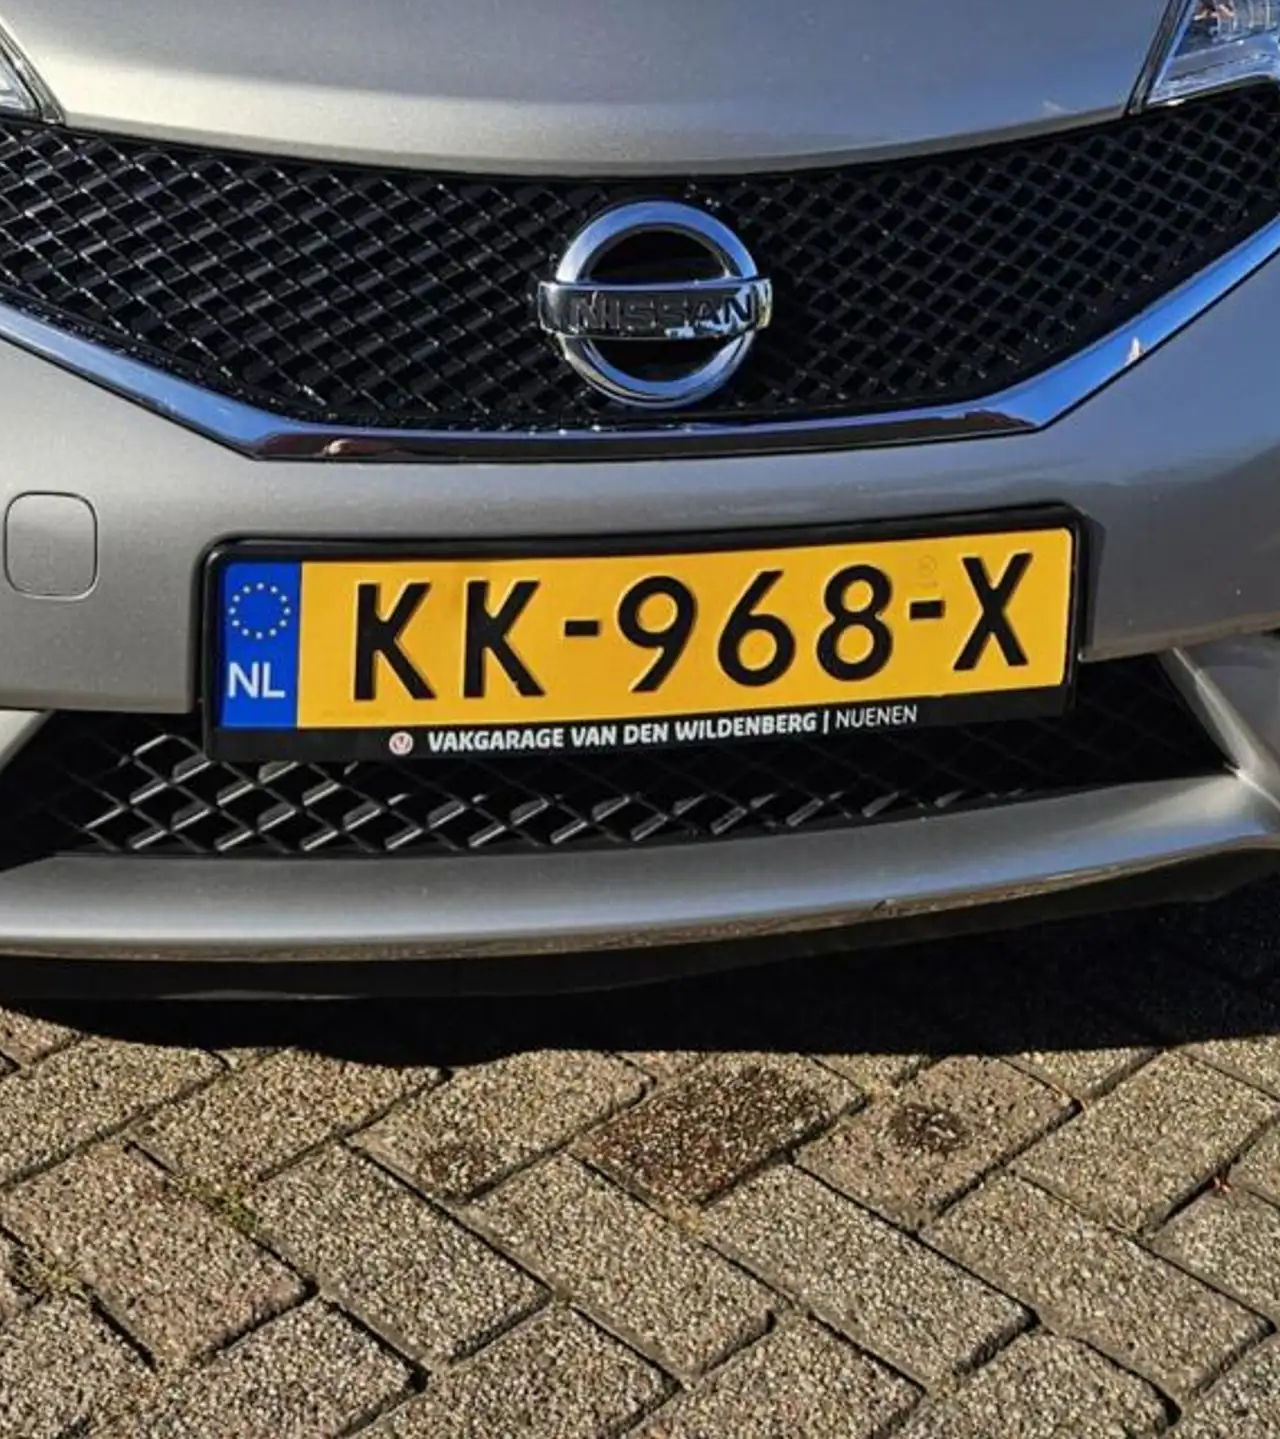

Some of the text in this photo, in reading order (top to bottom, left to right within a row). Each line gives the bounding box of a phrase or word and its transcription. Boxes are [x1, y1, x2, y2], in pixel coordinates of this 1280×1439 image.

[573, 291, 755, 332] NISSAN
[353, 551, 1034, 702] KK-968-X
[228, 661, 287, 699] NL
[427, 728, 565, 753] VAKGARAGE
[570, 724, 619, 748] VAN
[623, 721, 670, 746] DEN
[675, 712, 818, 742] WILDENBERG
[835, 704, 918, 729] NUENEN
